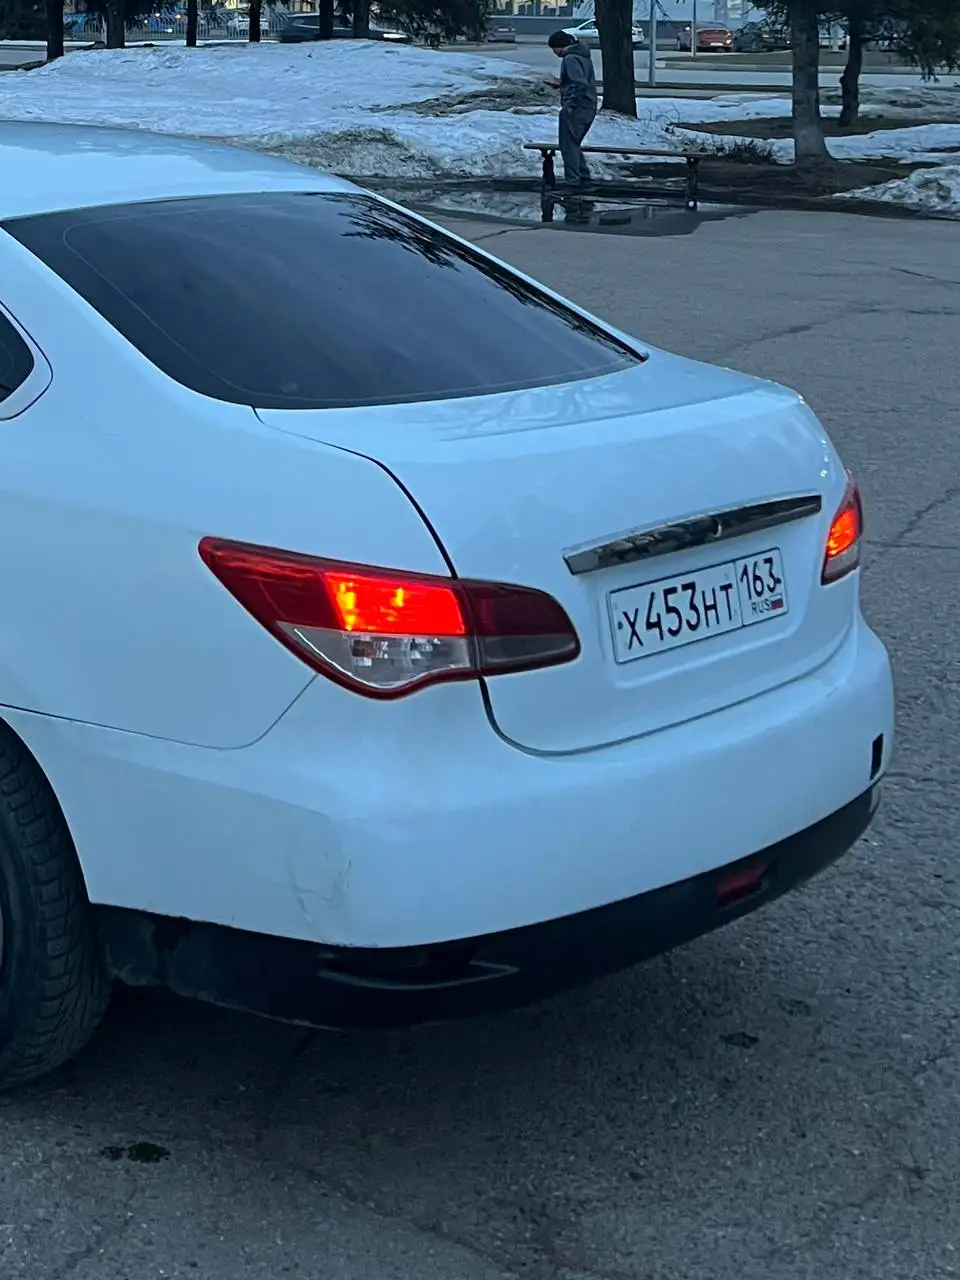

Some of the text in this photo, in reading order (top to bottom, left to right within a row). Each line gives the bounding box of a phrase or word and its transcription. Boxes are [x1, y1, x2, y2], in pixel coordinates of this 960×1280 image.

[622, 557, 777, 650] Х453НТ 163
[751, 598, 771, 616] RUS
